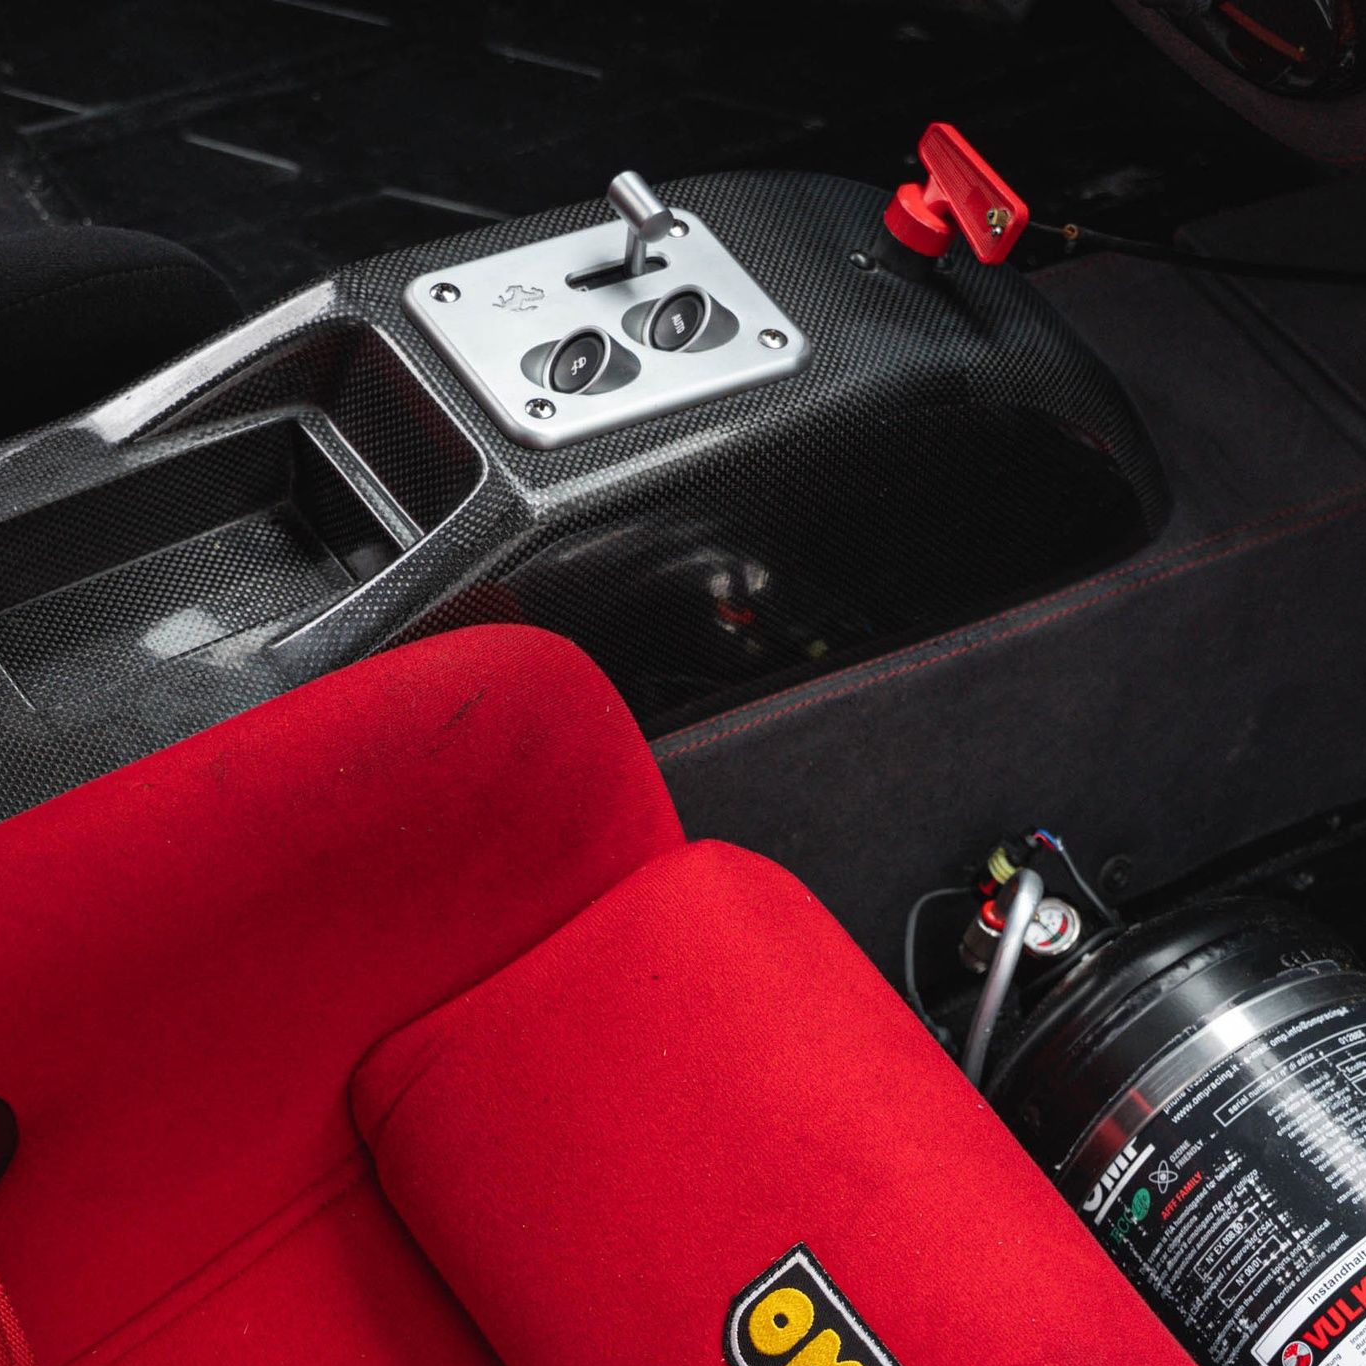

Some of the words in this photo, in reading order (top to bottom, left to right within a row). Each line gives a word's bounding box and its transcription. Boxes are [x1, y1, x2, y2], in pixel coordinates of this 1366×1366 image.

[671, 313, 686, 335] AUTO
[1169, 1062, 1240, 1125] www.ompracing.it
[1226, 1094, 1249, 1115] serial
[1168, 1138, 1191, 1163] OZONE
[1174, 1138, 1204, 1170] FRIENDLY
[1159, 1197, 1178, 1220] AFFF
[1174, 1169, 1204, 1203] FAMILY
[1211, 1200, 1224, 1214] FIA
[1164, 1224, 1175, 1237] FIA
[1212, 1241, 1225, 1255] EX
[1242, 1294, 1254, 1307] the
[1251, 1272, 1274, 1297] current
[1288, 1244, 1302, 1257] and
[1243, 1256, 1262, 1276] 00/01
[1255, 1303, 1274, 1324] norme
[1271, 1279, 1297, 1307] sportive
[1324, 1230, 1349, 1255] vigenti.
